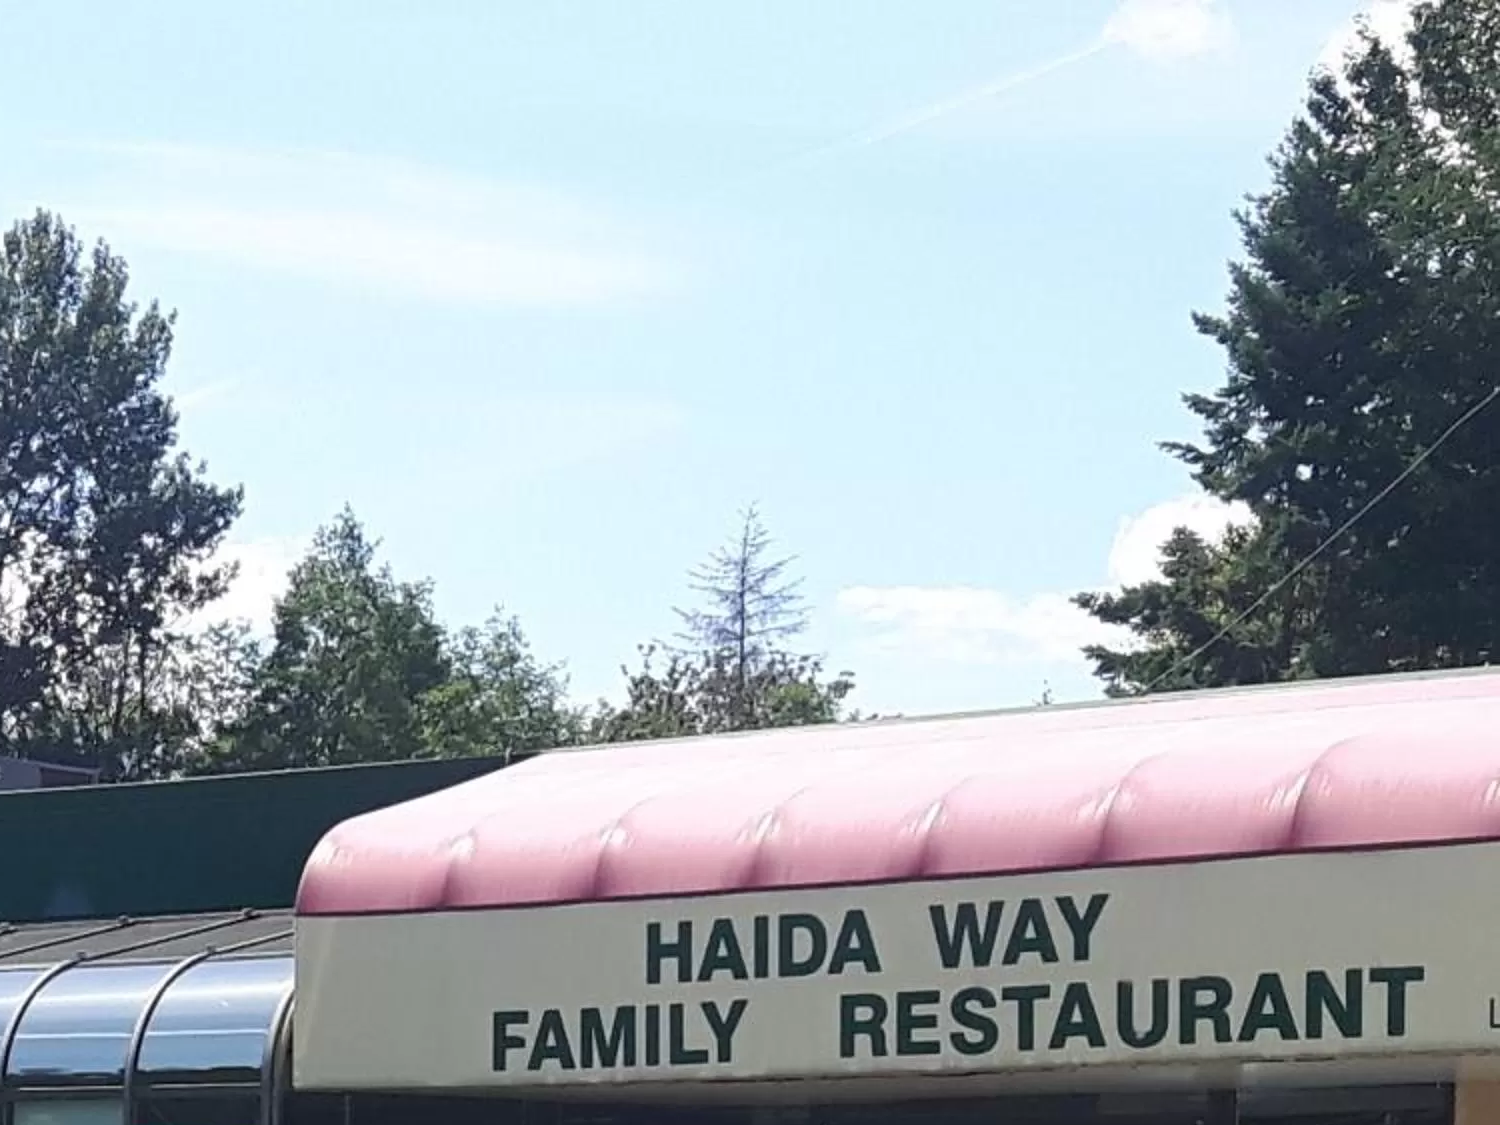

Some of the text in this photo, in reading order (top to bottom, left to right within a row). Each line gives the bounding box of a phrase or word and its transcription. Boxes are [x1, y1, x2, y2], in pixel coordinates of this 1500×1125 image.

[646, 893, 1109, 985] HAIDA WAY
[492, 965, 1425, 1072] FAMILY RESTAURANT
